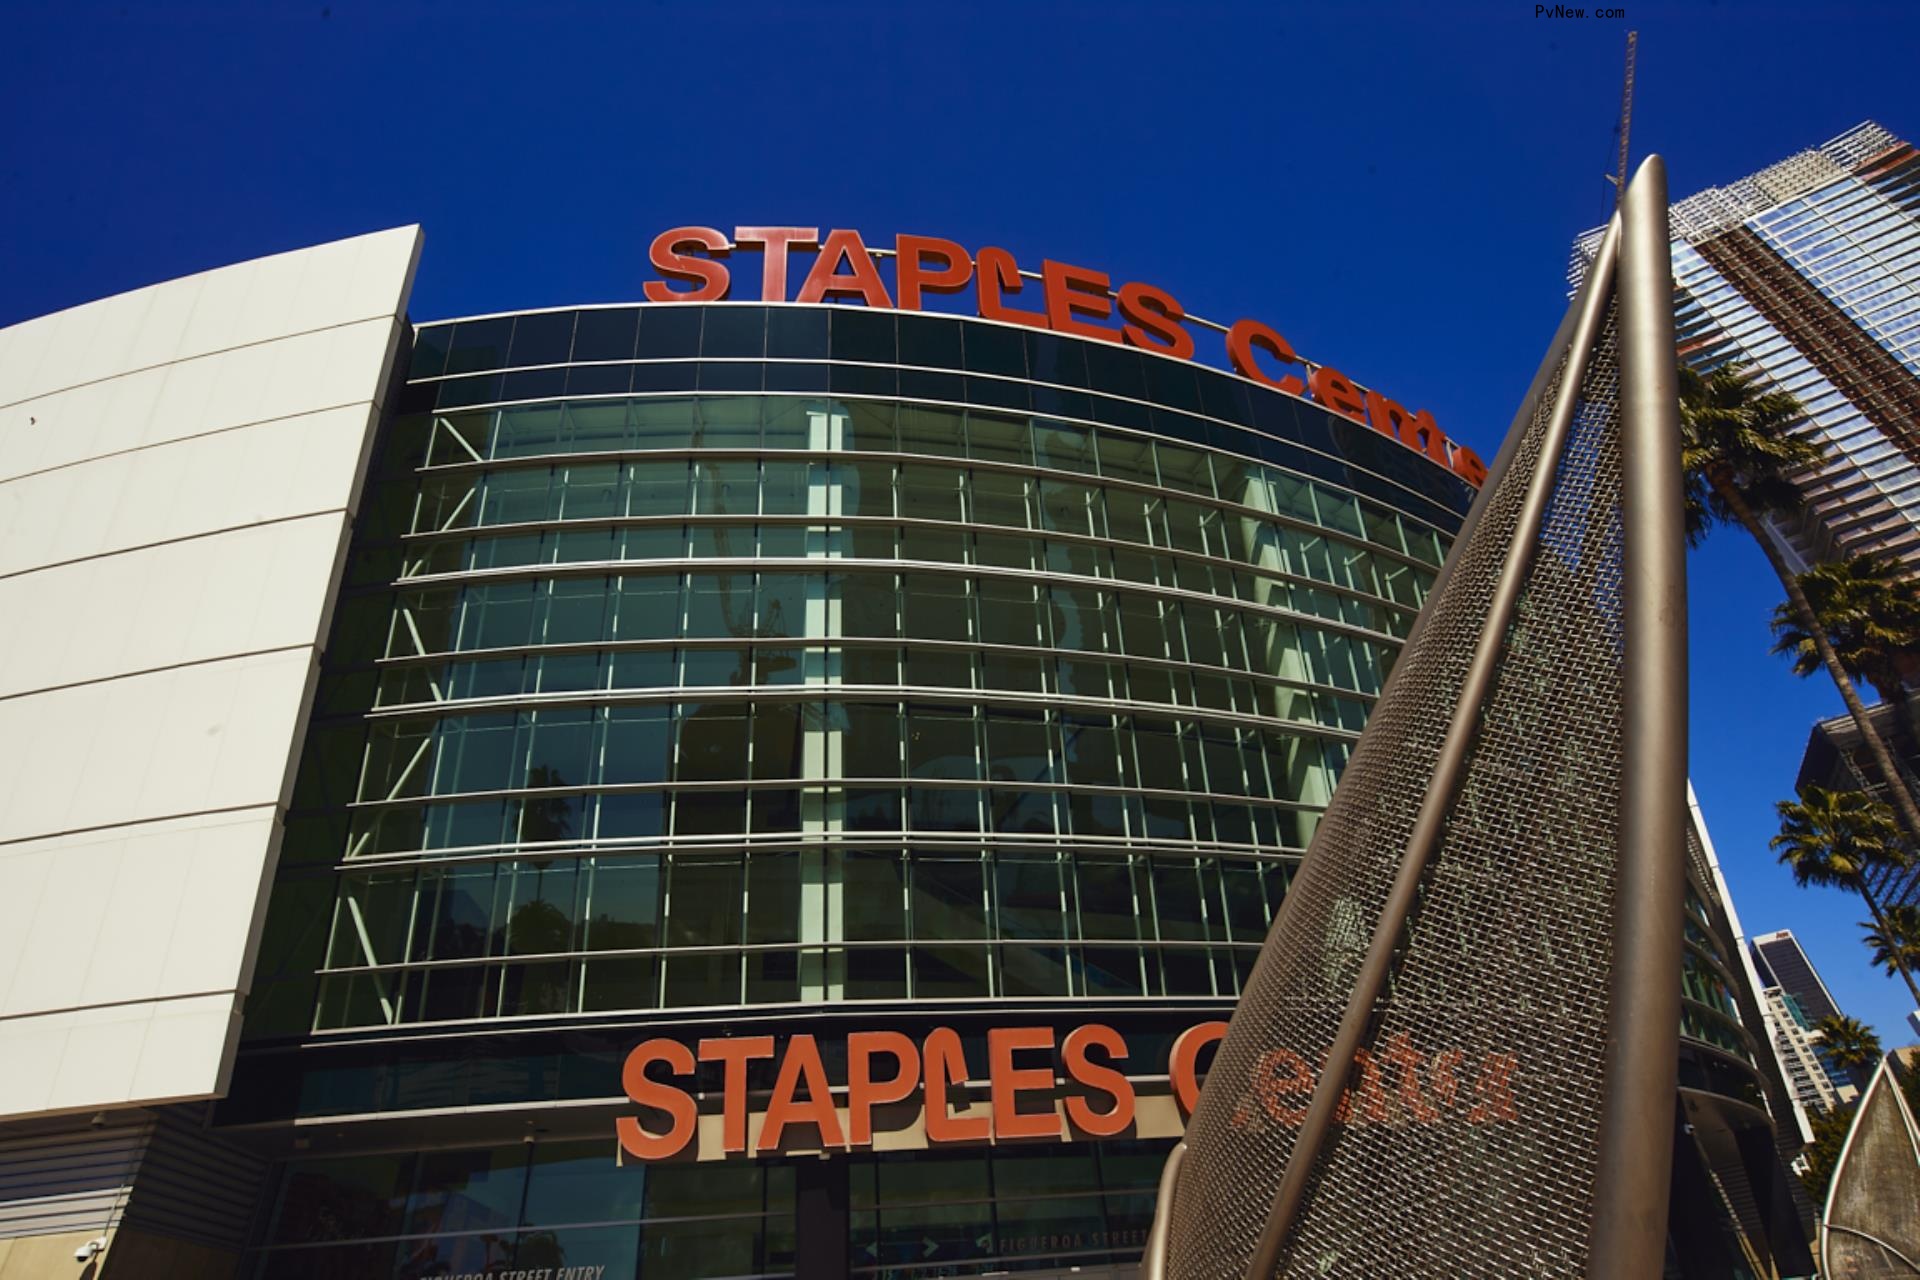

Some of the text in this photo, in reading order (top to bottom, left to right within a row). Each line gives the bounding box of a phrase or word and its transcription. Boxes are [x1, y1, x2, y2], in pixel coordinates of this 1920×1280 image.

[643, 225, 1488, 488] STAPLES Cente
[616, 1023, 1136, 1160] STAPLES
[556, 1264, 606, 1280] ENTRY
